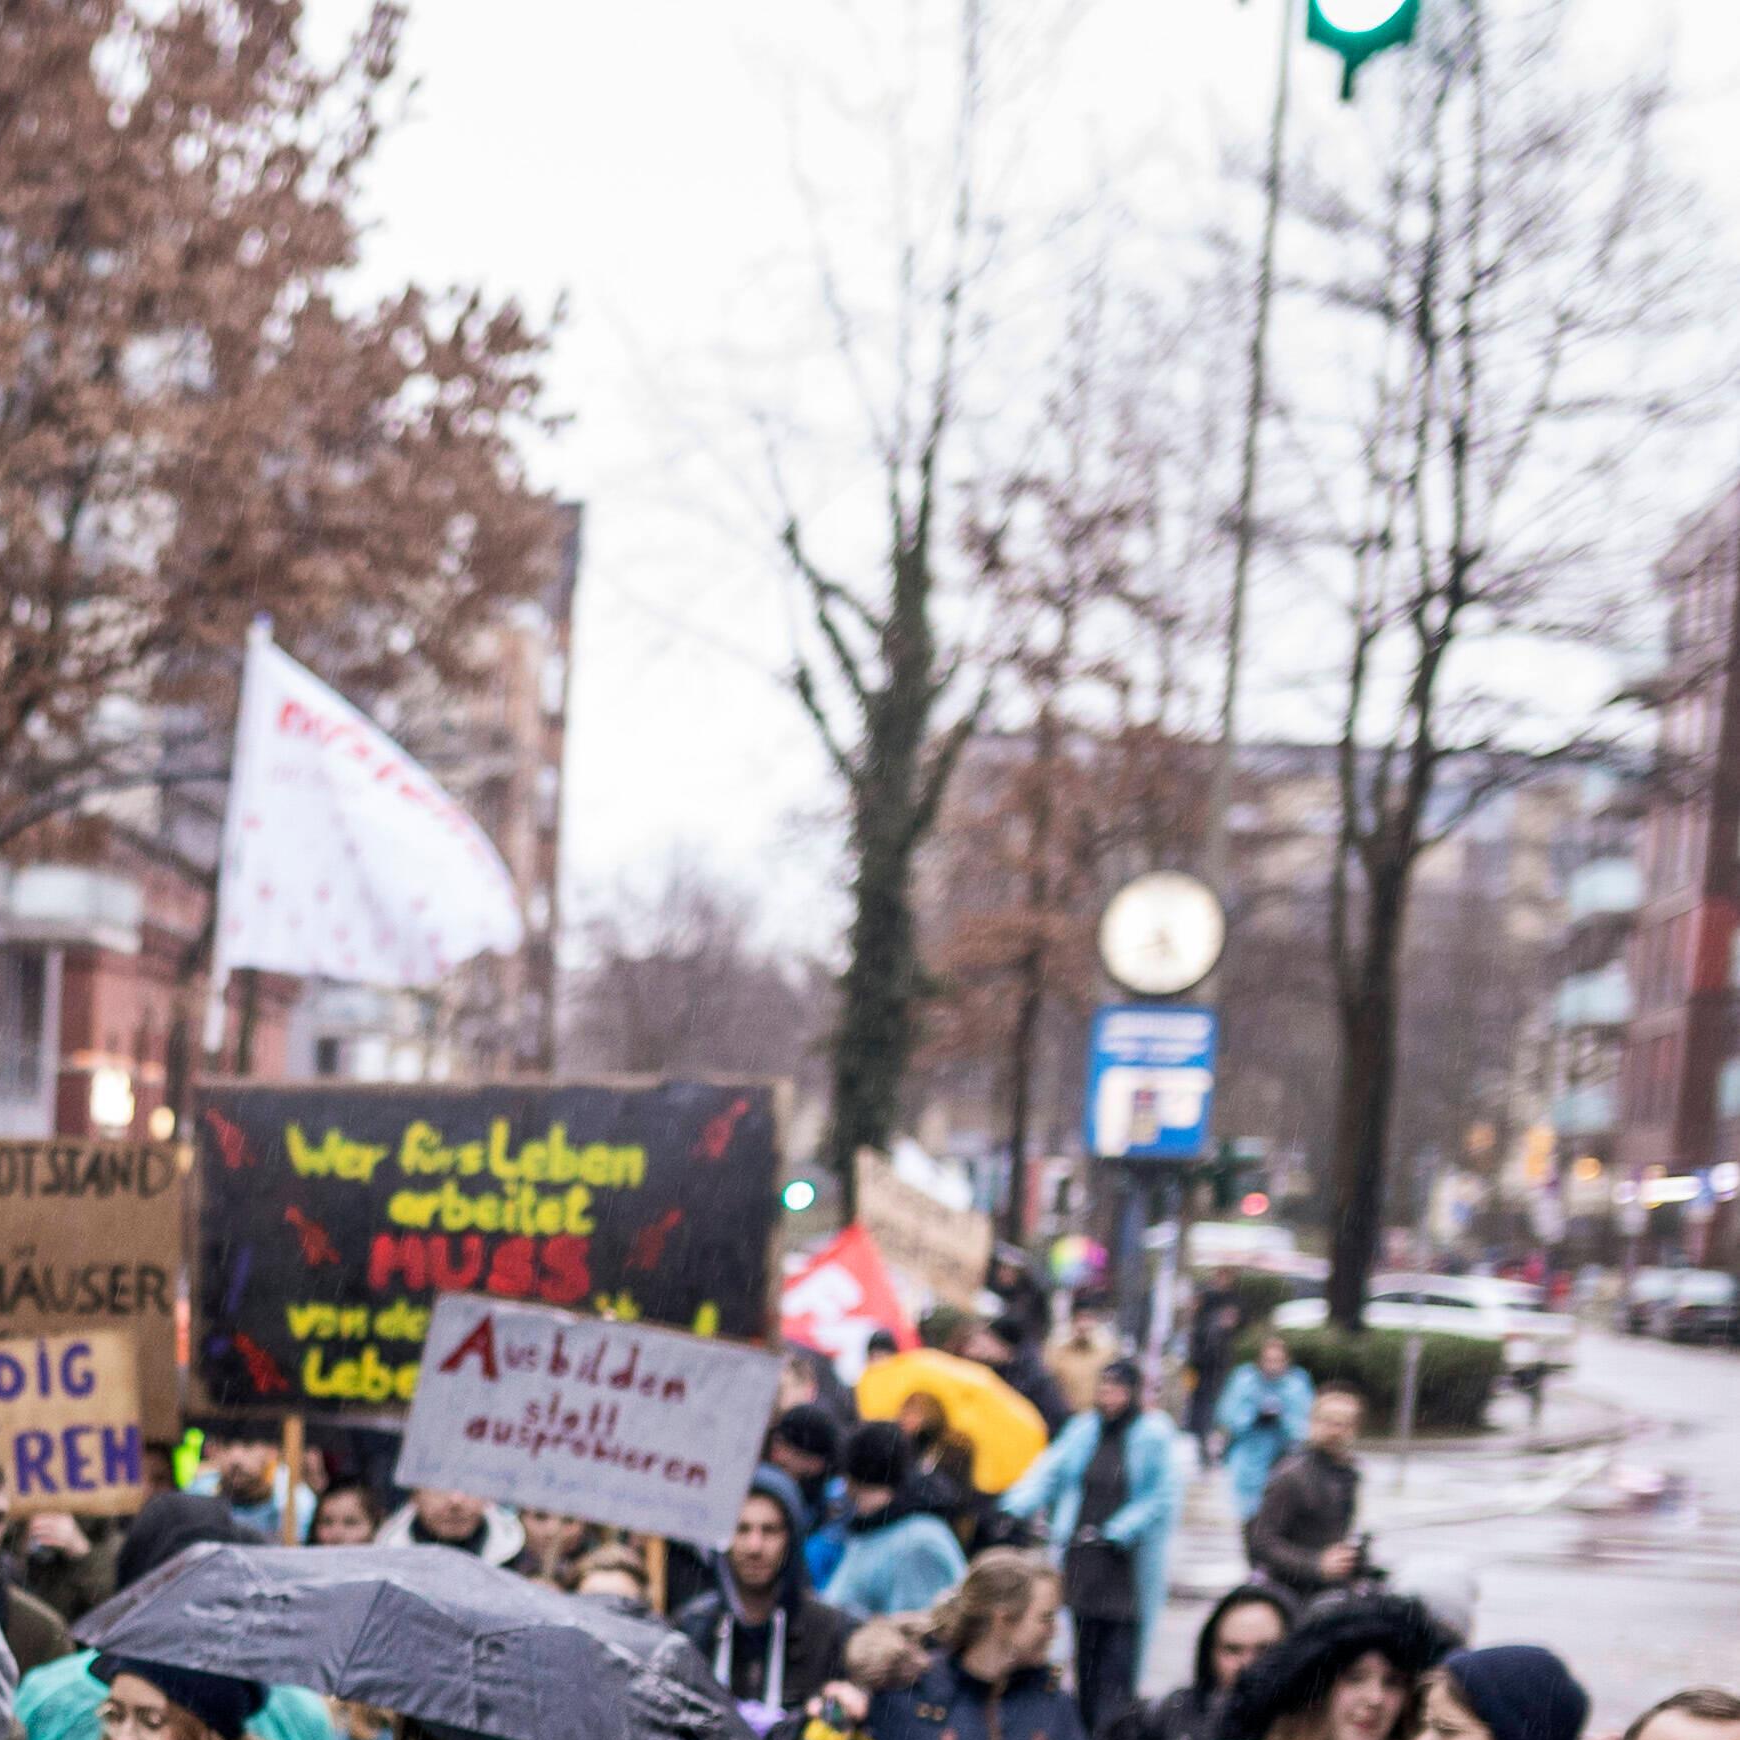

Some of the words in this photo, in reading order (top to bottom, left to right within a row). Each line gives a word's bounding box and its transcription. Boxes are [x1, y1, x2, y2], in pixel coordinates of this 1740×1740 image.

[285, 1120, 389, 1183] Wer
[489, 1115, 648, 1189] Leben
[387, 1178, 596, 1237] arbeitet
[367, 1233, 591, 1304] MUSS
[286, 1302, 369, 1341] von
[303, 1345, 421, 1402] Lebe
[439, 1314, 686, 1403] Ausbilden
[525, 1391, 621, 1438] statt
[464, 1414, 709, 1488] ausprobieren
